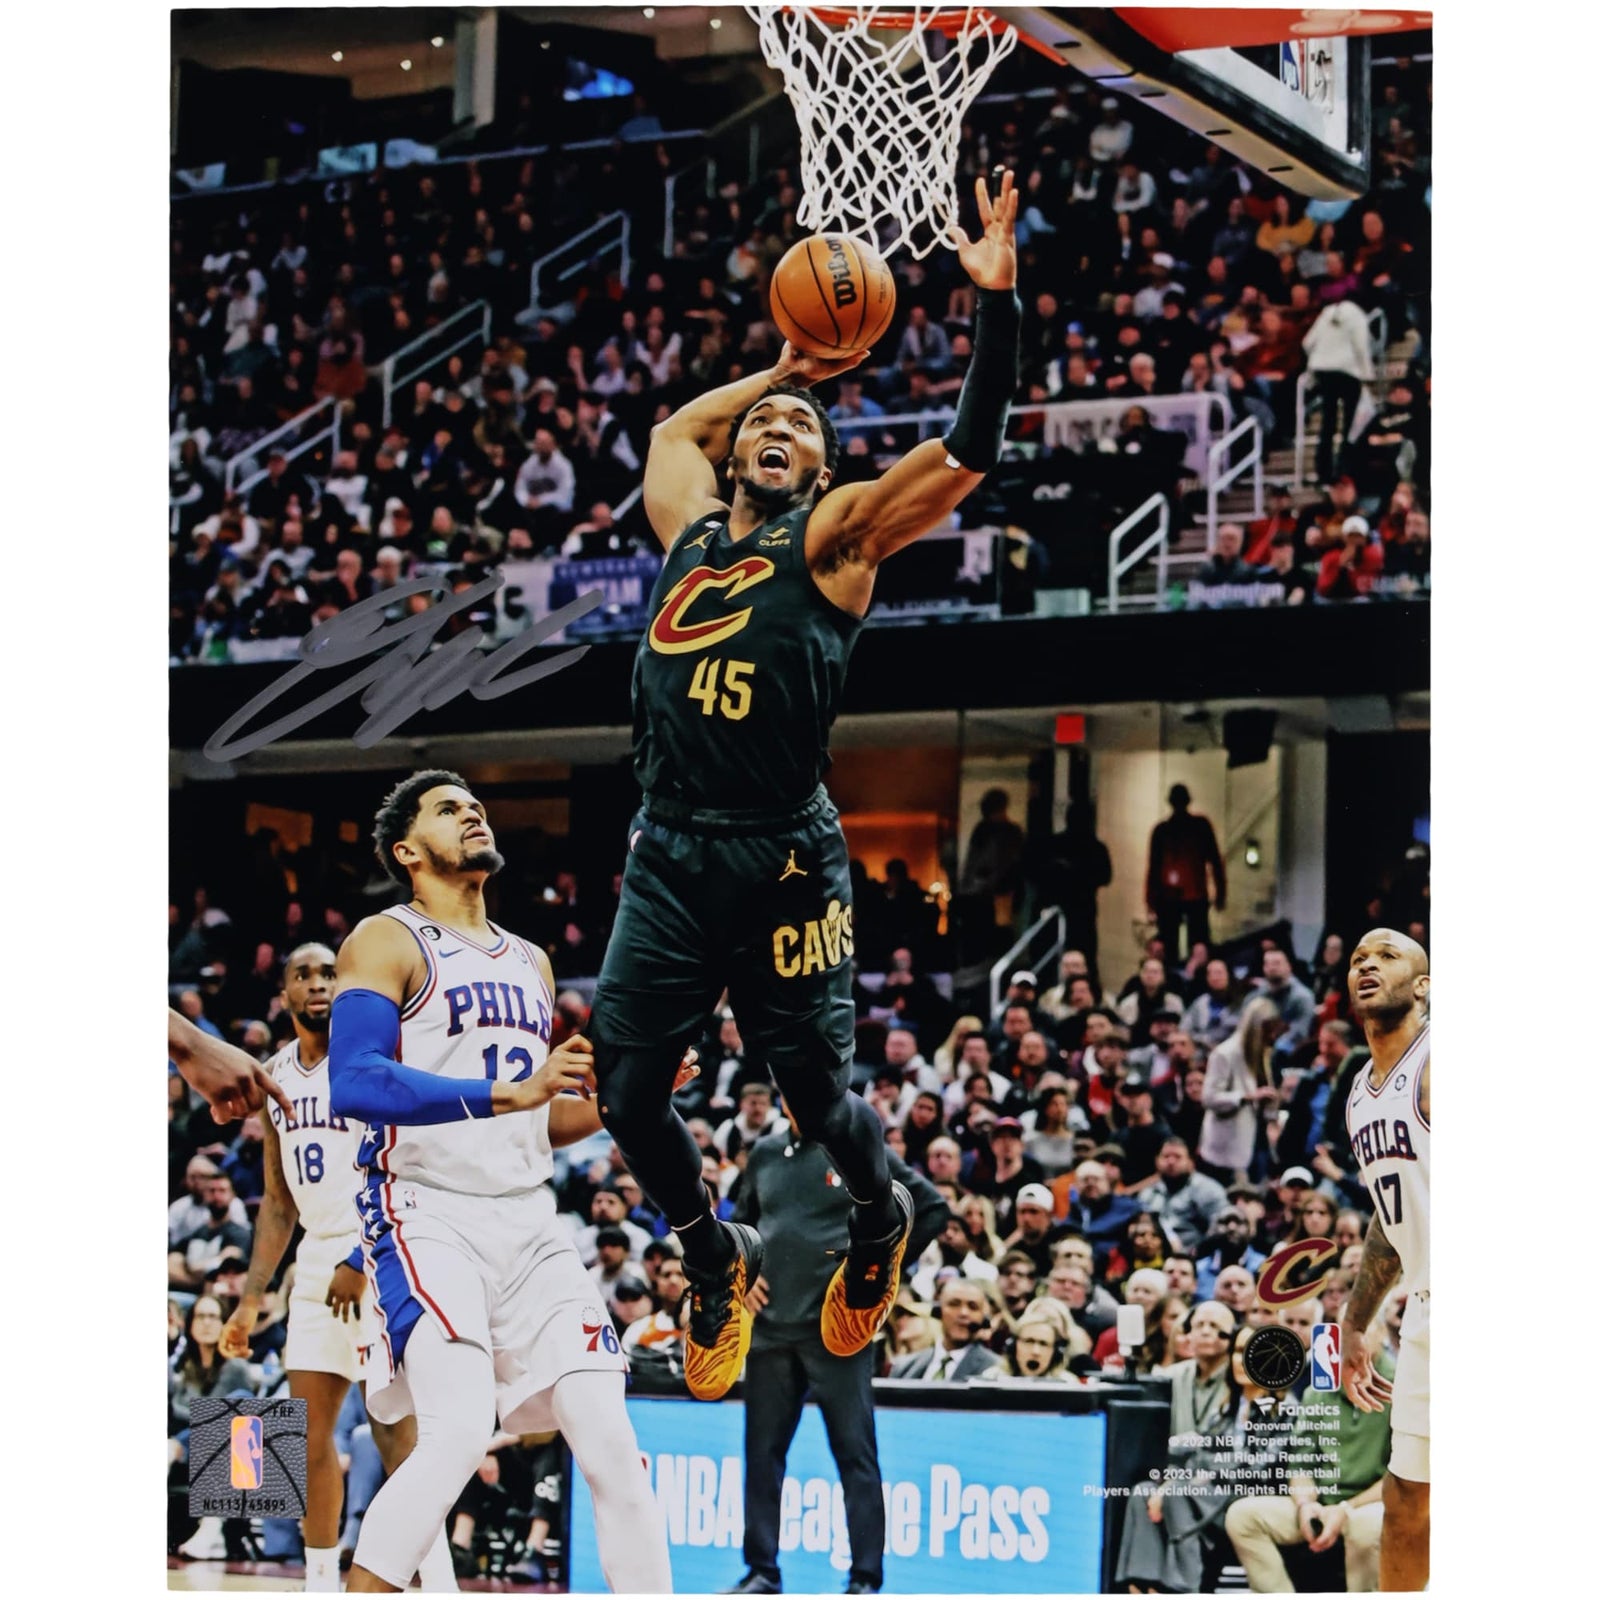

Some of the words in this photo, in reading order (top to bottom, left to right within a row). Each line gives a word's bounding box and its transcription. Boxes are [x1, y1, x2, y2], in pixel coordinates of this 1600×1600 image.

[649, 555, 775, 655] C
[688, 656, 756, 720] 45
[482, 1043, 533, 1082] 12
[294, 1142, 325, 1185] 18
[1374, 1172, 1403, 1225] 17
[582, 1322, 619, 1355] 76
[656, 1454, 744, 1548] NBA
[929, 1464, 1051, 1563] Pass
